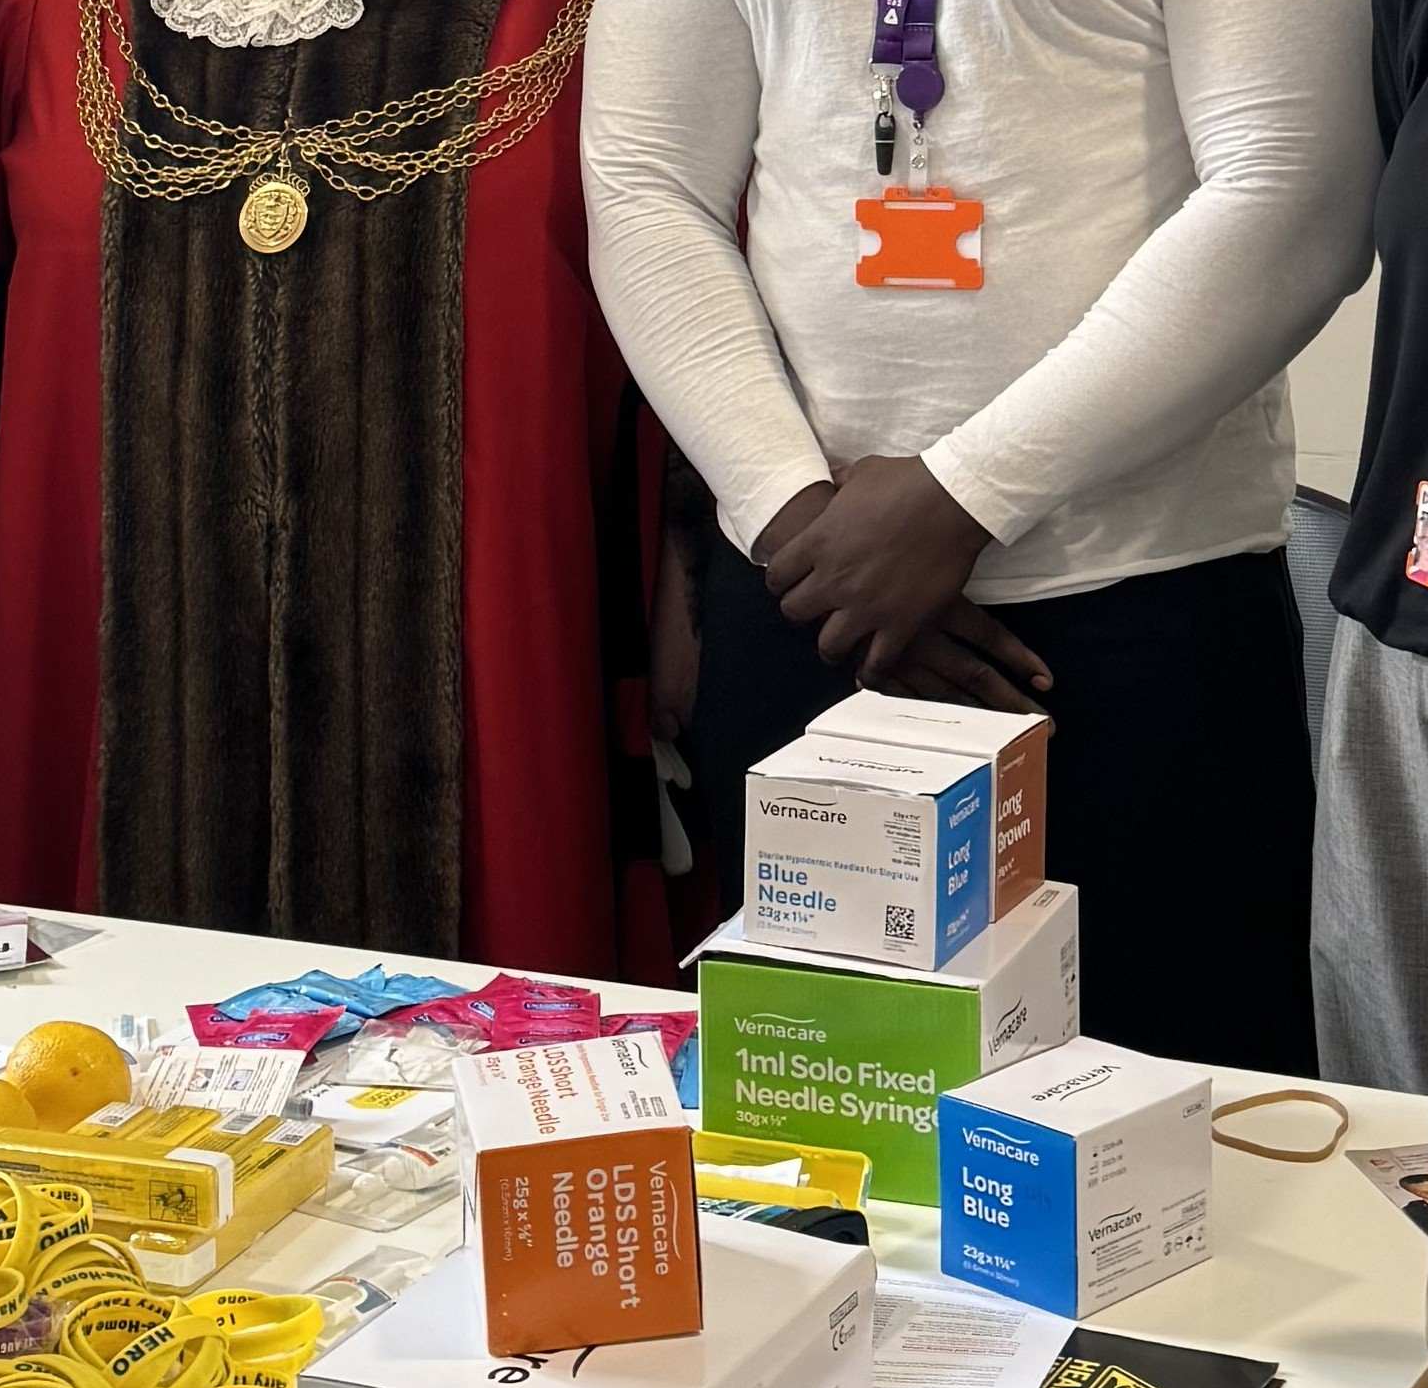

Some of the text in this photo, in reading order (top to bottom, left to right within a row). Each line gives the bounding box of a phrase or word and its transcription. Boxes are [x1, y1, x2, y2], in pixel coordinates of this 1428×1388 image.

[759, 799, 848, 825] Vernacare
[997, 788, 1023, 822] Long
[997, 817, 1031, 854] Brown
[948, 839, 970, 870] Long
[758, 863, 808, 886] Blue
[947, 869, 969, 896] Blue
[758, 884, 837, 912] Needle
[734, 1016, 828, 1044] Vernacare
[736, 1047, 936, 1095] 1ml Solo Fixed
[1030, 1064, 1121, 1102] Vernacare
[529, 1090, 557, 1135] Needle
[735, 1079, 836, 1114] Needle
[736, 1109, 761, 1127] 30g
[962, 1127, 1040, 1167] Vernacare
[512, 1176, 530, 1221] 25g x
[962, 1165, 1014, 1207] Long
[552, 1170, 580, 1270] Needle
[584, 1167, 609, 1277] Orange
[648, 1160, 669, 1276] Vernacare
[963, 1194, 1010, 1229] Blue
[1088, 1211, 1142, 1243] Vernacare
[611, 1163, 641, 1310] LDS Short
[963, 1244, 985, 1264] 23g
[112, 1326, 175, 1377] HERO
